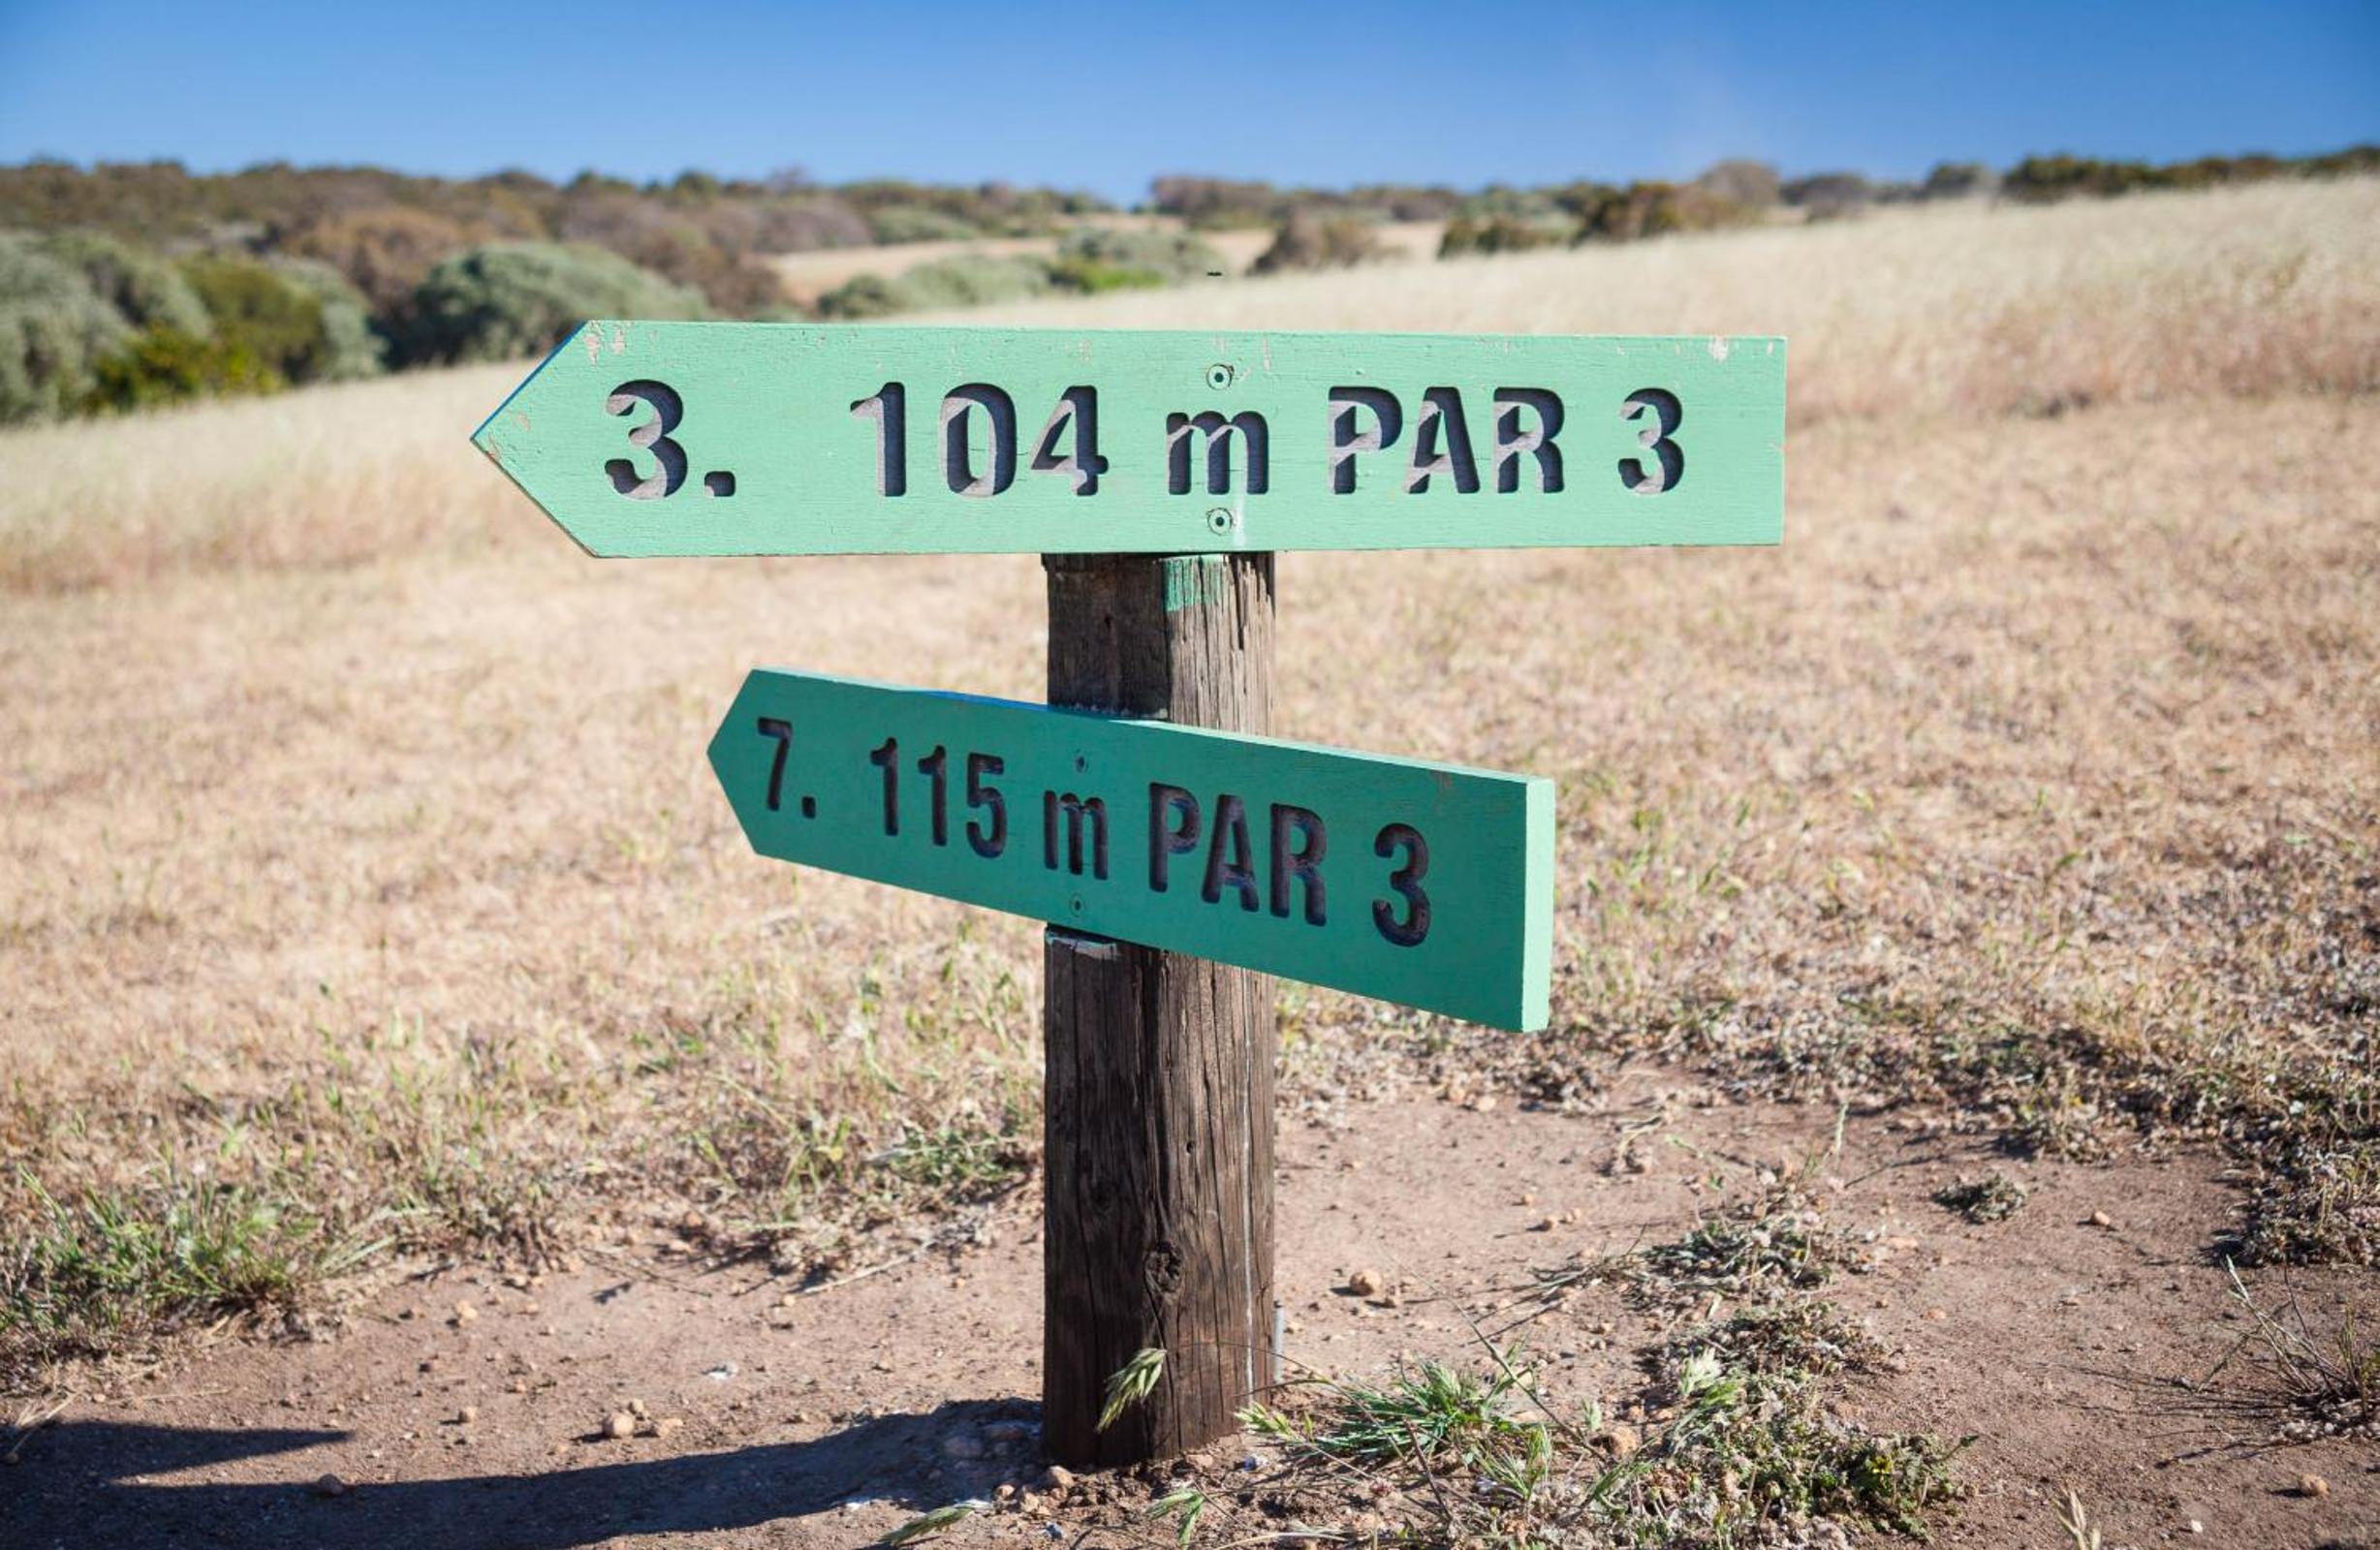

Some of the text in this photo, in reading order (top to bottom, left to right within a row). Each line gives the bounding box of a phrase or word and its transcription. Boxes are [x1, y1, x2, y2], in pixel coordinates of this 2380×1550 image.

[605, 379, 1685, 500] 3. 104 m PAR 3
[757, 717, 1431, 947] 7. 115 m PAR 3
